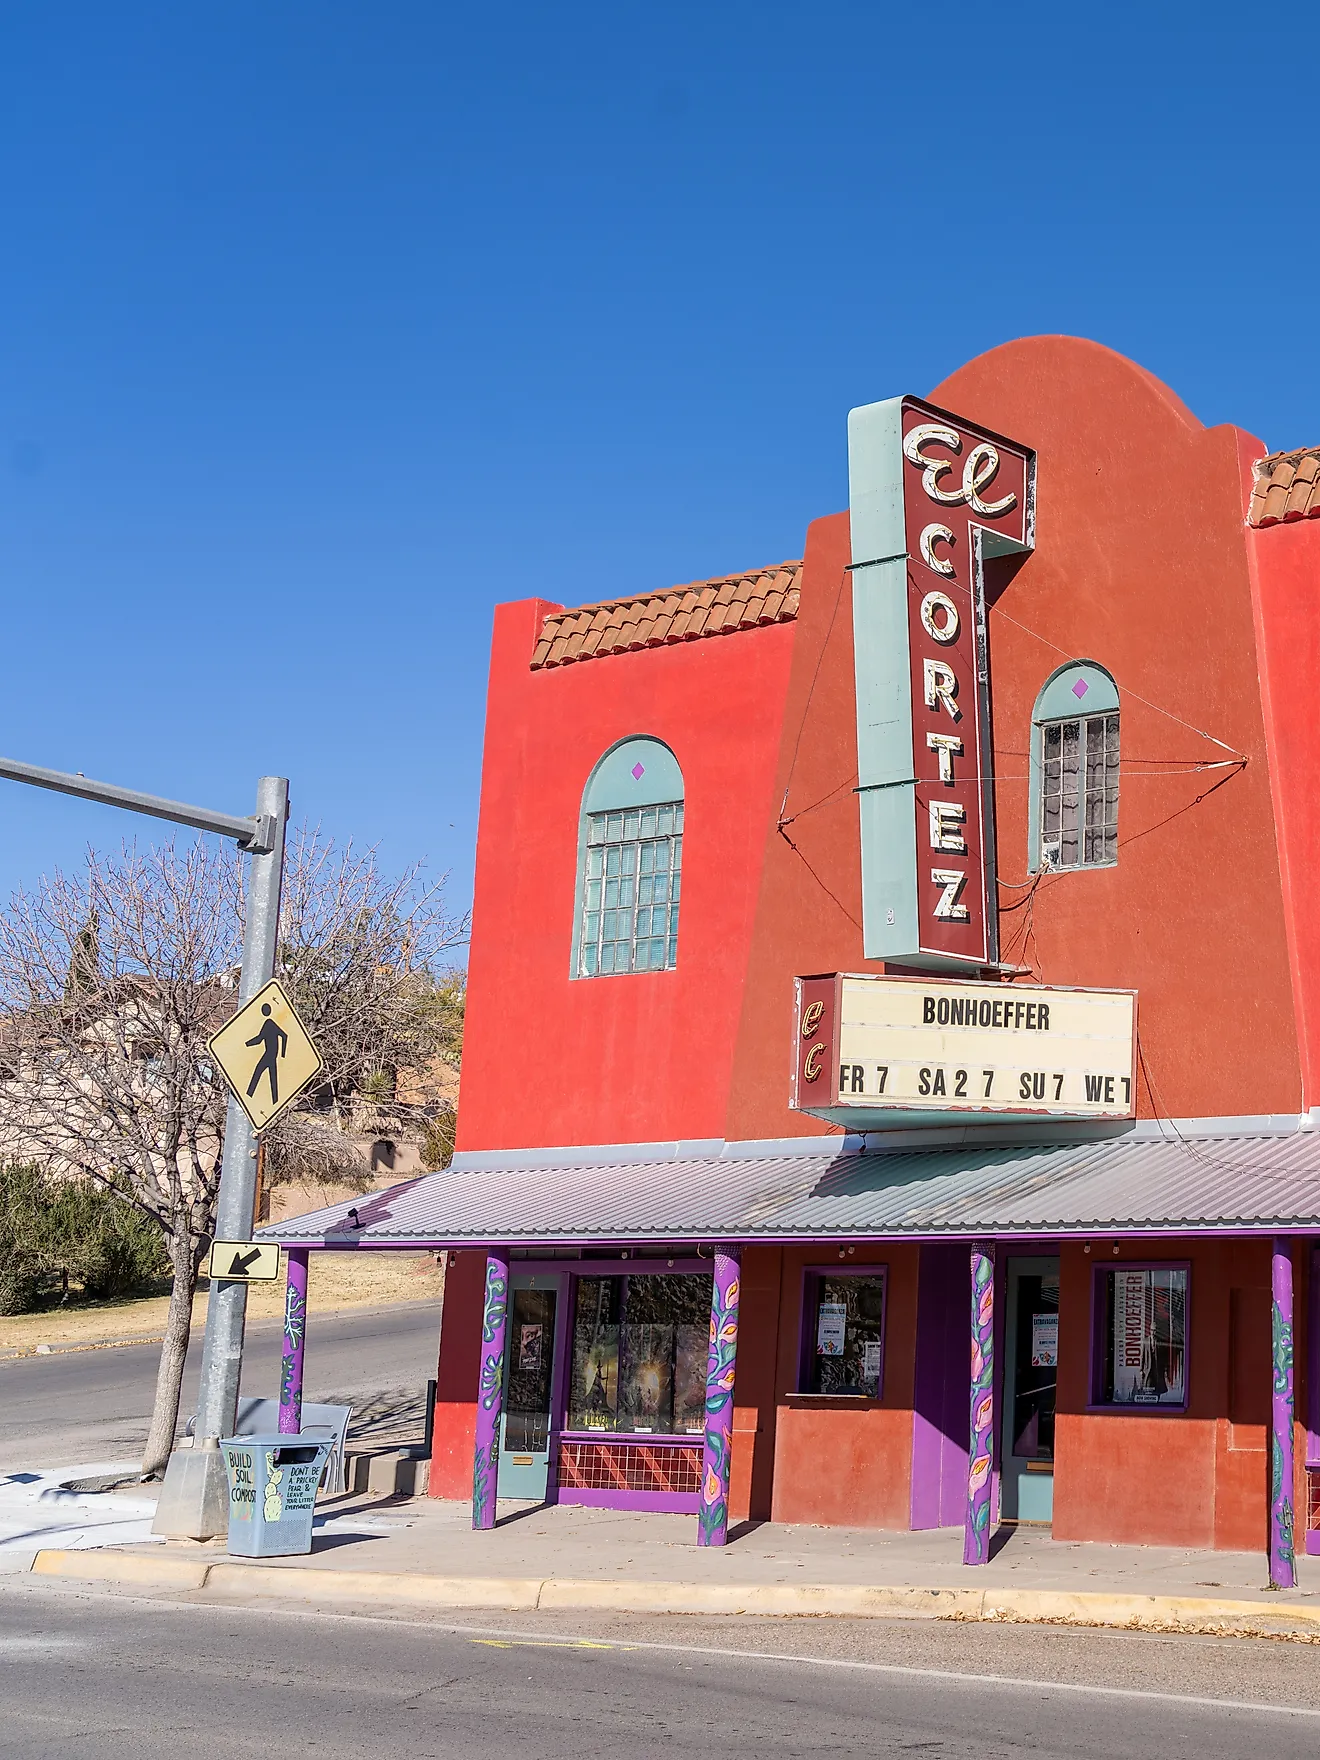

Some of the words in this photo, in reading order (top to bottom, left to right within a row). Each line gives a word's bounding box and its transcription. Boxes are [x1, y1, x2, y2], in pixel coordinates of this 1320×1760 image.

[902, 423, 1017, 516] El
[918, 521, 970, 921] CORTEZ
[923, 996, 1050, 1031] BONHOEFFER
[839, 1064, 865, 1093] FR
[876, 1065, 889, 1094] 7
[918, 1067, 946, 1096] SA
[954, 1069, 968, 1097] 2
[982, 1070, 995, 1098] 7
[1019, 1072, 1046, 1100] SU
[1052, 1073, 1065, 1101] 7
[1084, 1074, 1115, 1103] WE
[1125, 1275, 1142, 1367] BONHOEFFER
[228, 1451, 252, 1468] BUILD
[311, 1466, 321, 1476] BE
[288, 1477, 293, 1485] A
[304, 1483, 310, 1492] &
